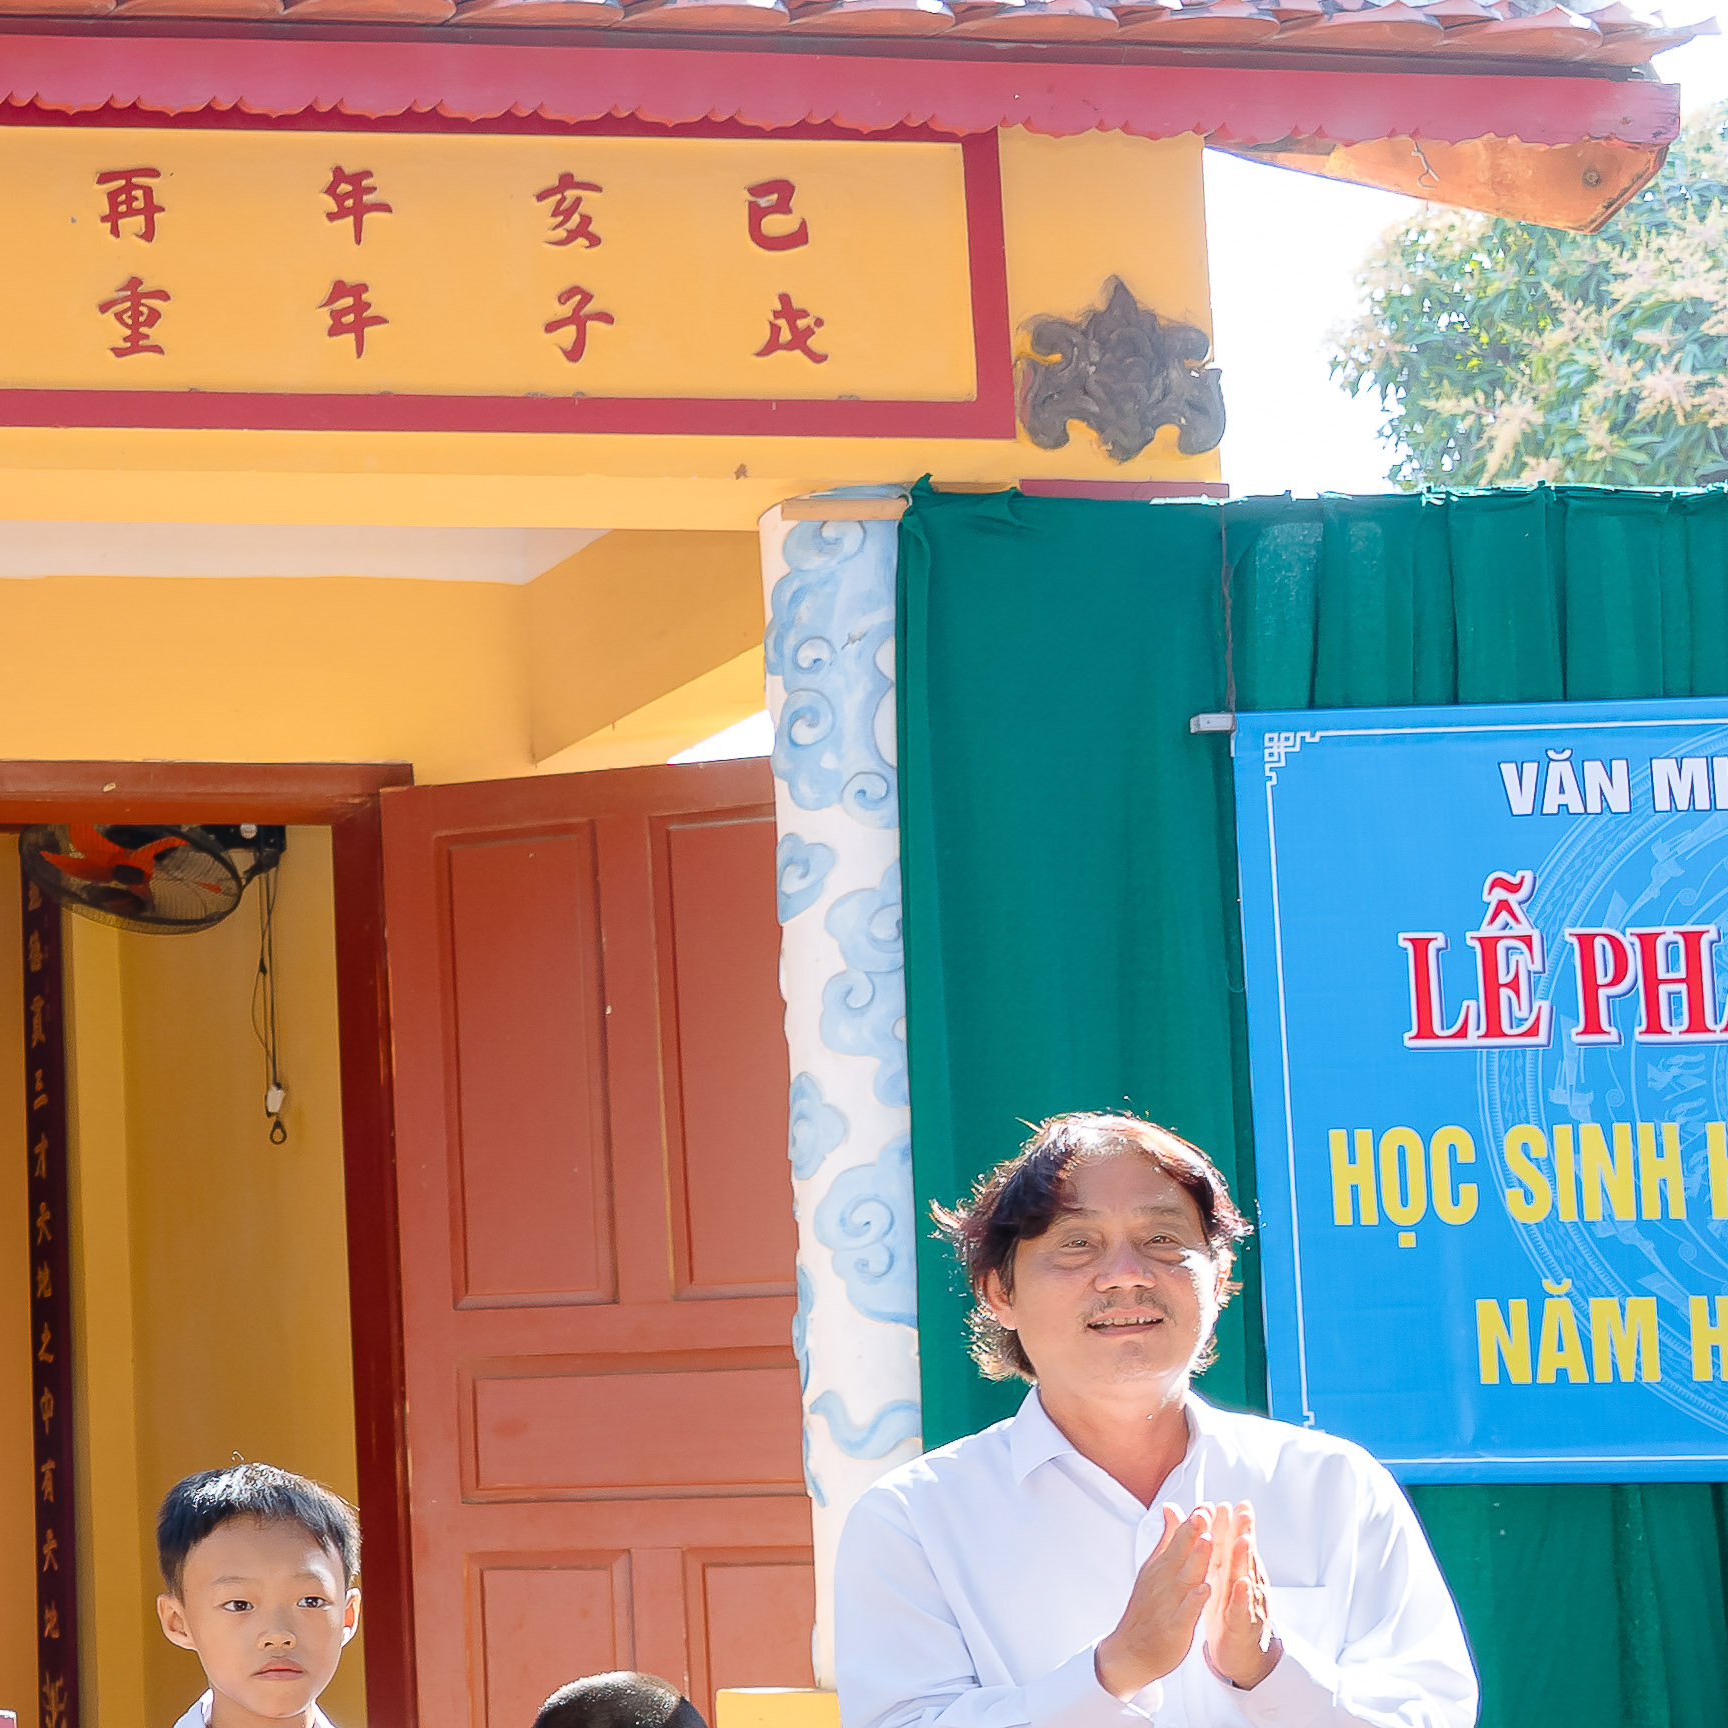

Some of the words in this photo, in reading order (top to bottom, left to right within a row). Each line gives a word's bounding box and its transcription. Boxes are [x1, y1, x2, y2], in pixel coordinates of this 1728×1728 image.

[1498, 748, 1631, 815] VĂN
[1398, 870, 1553, 1050] LỄ
[1568, 923, 1728, 1048] PH
[1328, 1126, 1479, 1248] HỌC
[1504, 1121, 1687, 1226] SINH
[1476, 1278, 1662, 1385] NĂM
